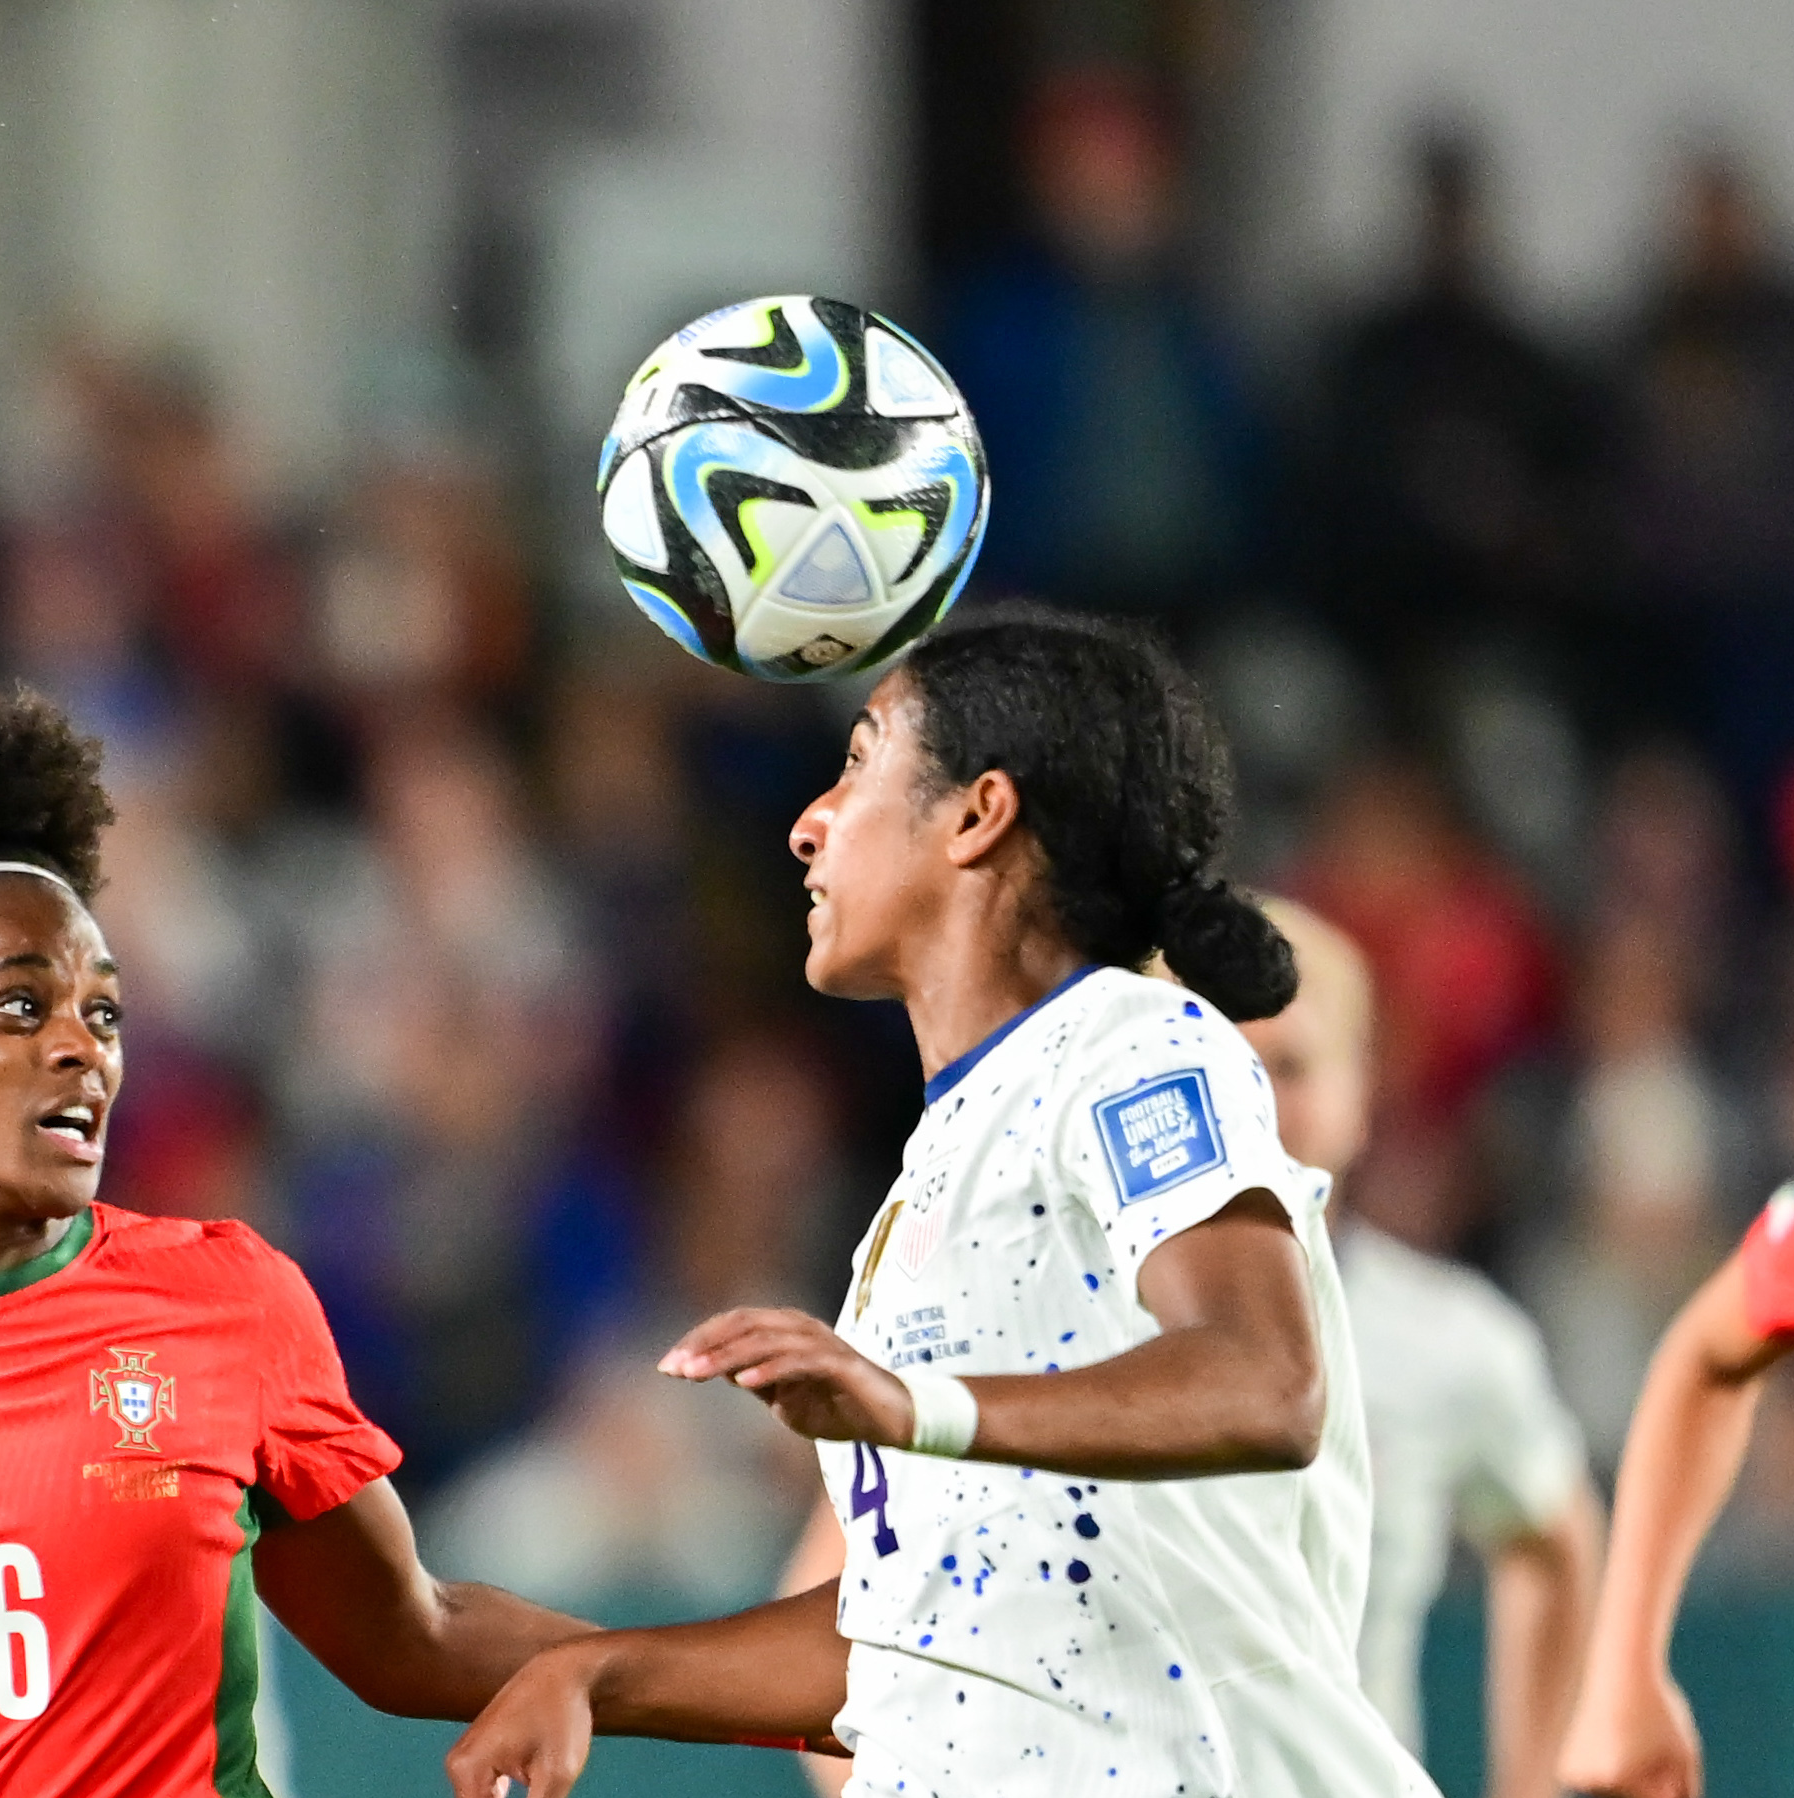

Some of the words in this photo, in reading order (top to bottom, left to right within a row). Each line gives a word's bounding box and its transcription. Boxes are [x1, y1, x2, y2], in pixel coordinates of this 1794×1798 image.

[1118, 1086, 1185, 1126] FOOTBALL
[1123, 1102, 1190, 1147] UNITES
[851, 1440, 899, 1557] 4
